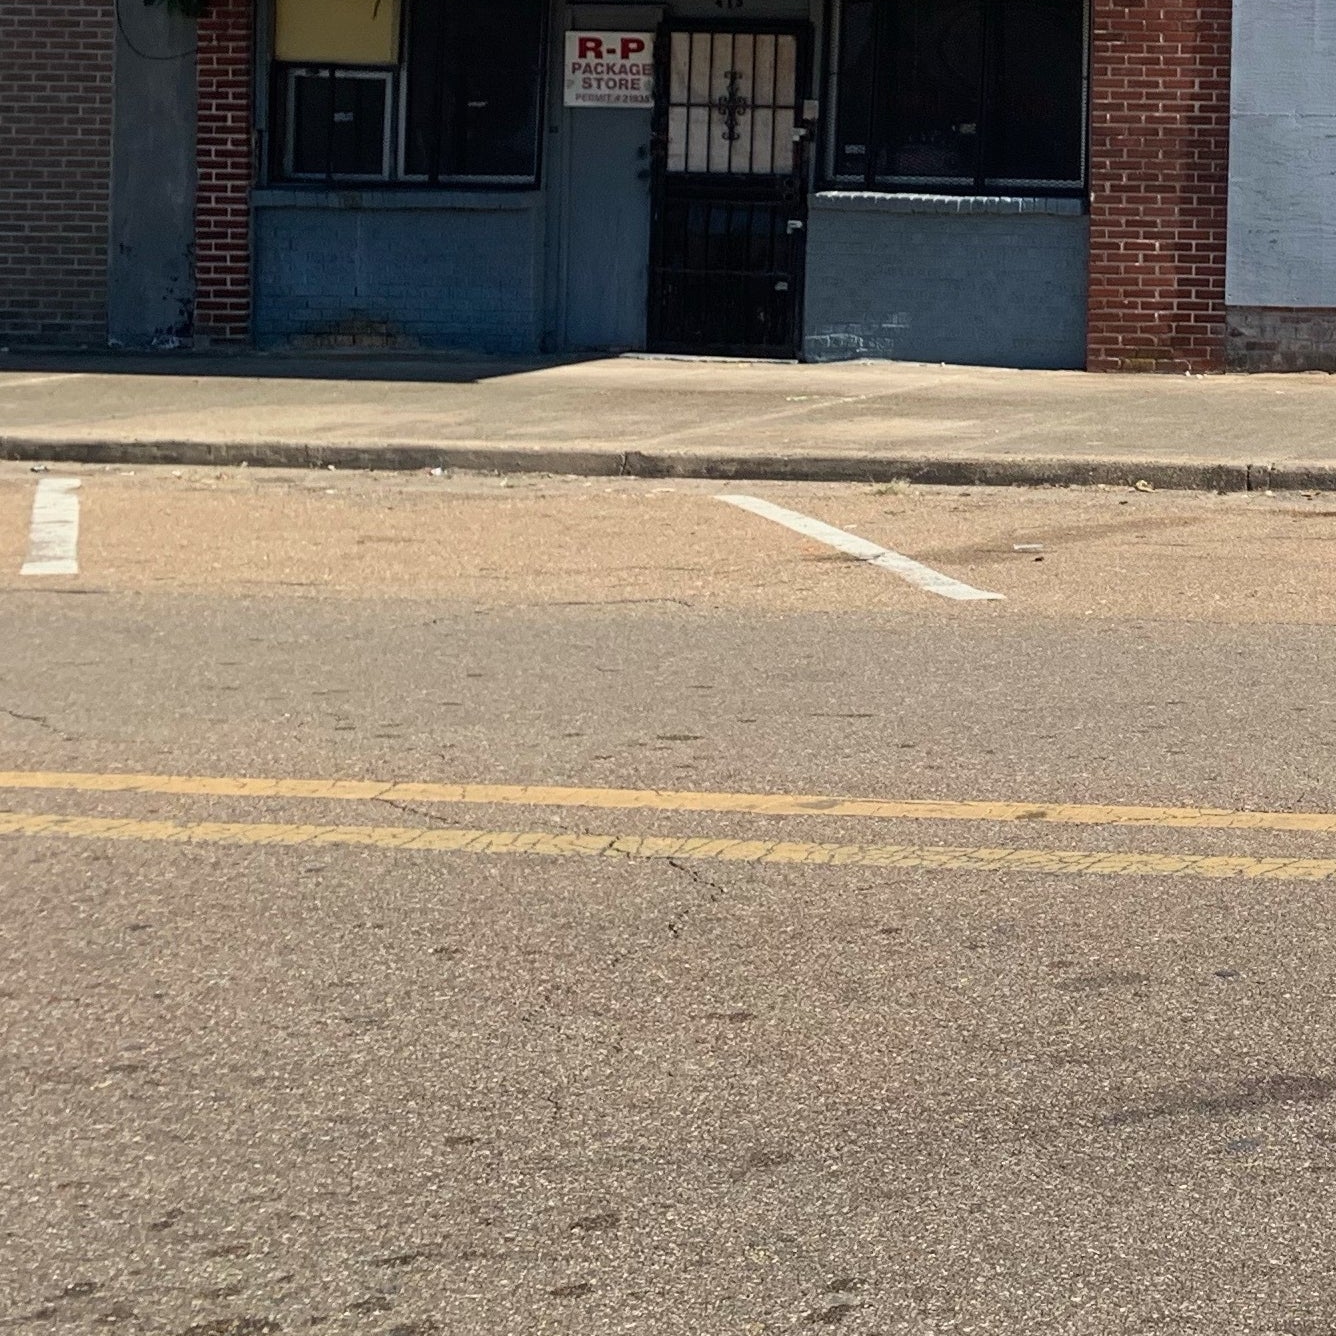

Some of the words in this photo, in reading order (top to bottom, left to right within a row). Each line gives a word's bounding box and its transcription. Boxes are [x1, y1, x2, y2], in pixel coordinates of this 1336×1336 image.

[578, 37, 645, 59] R-P
[572, 62, 653, 76] PACKAGE
[582, 77, 640, 90] STORE
